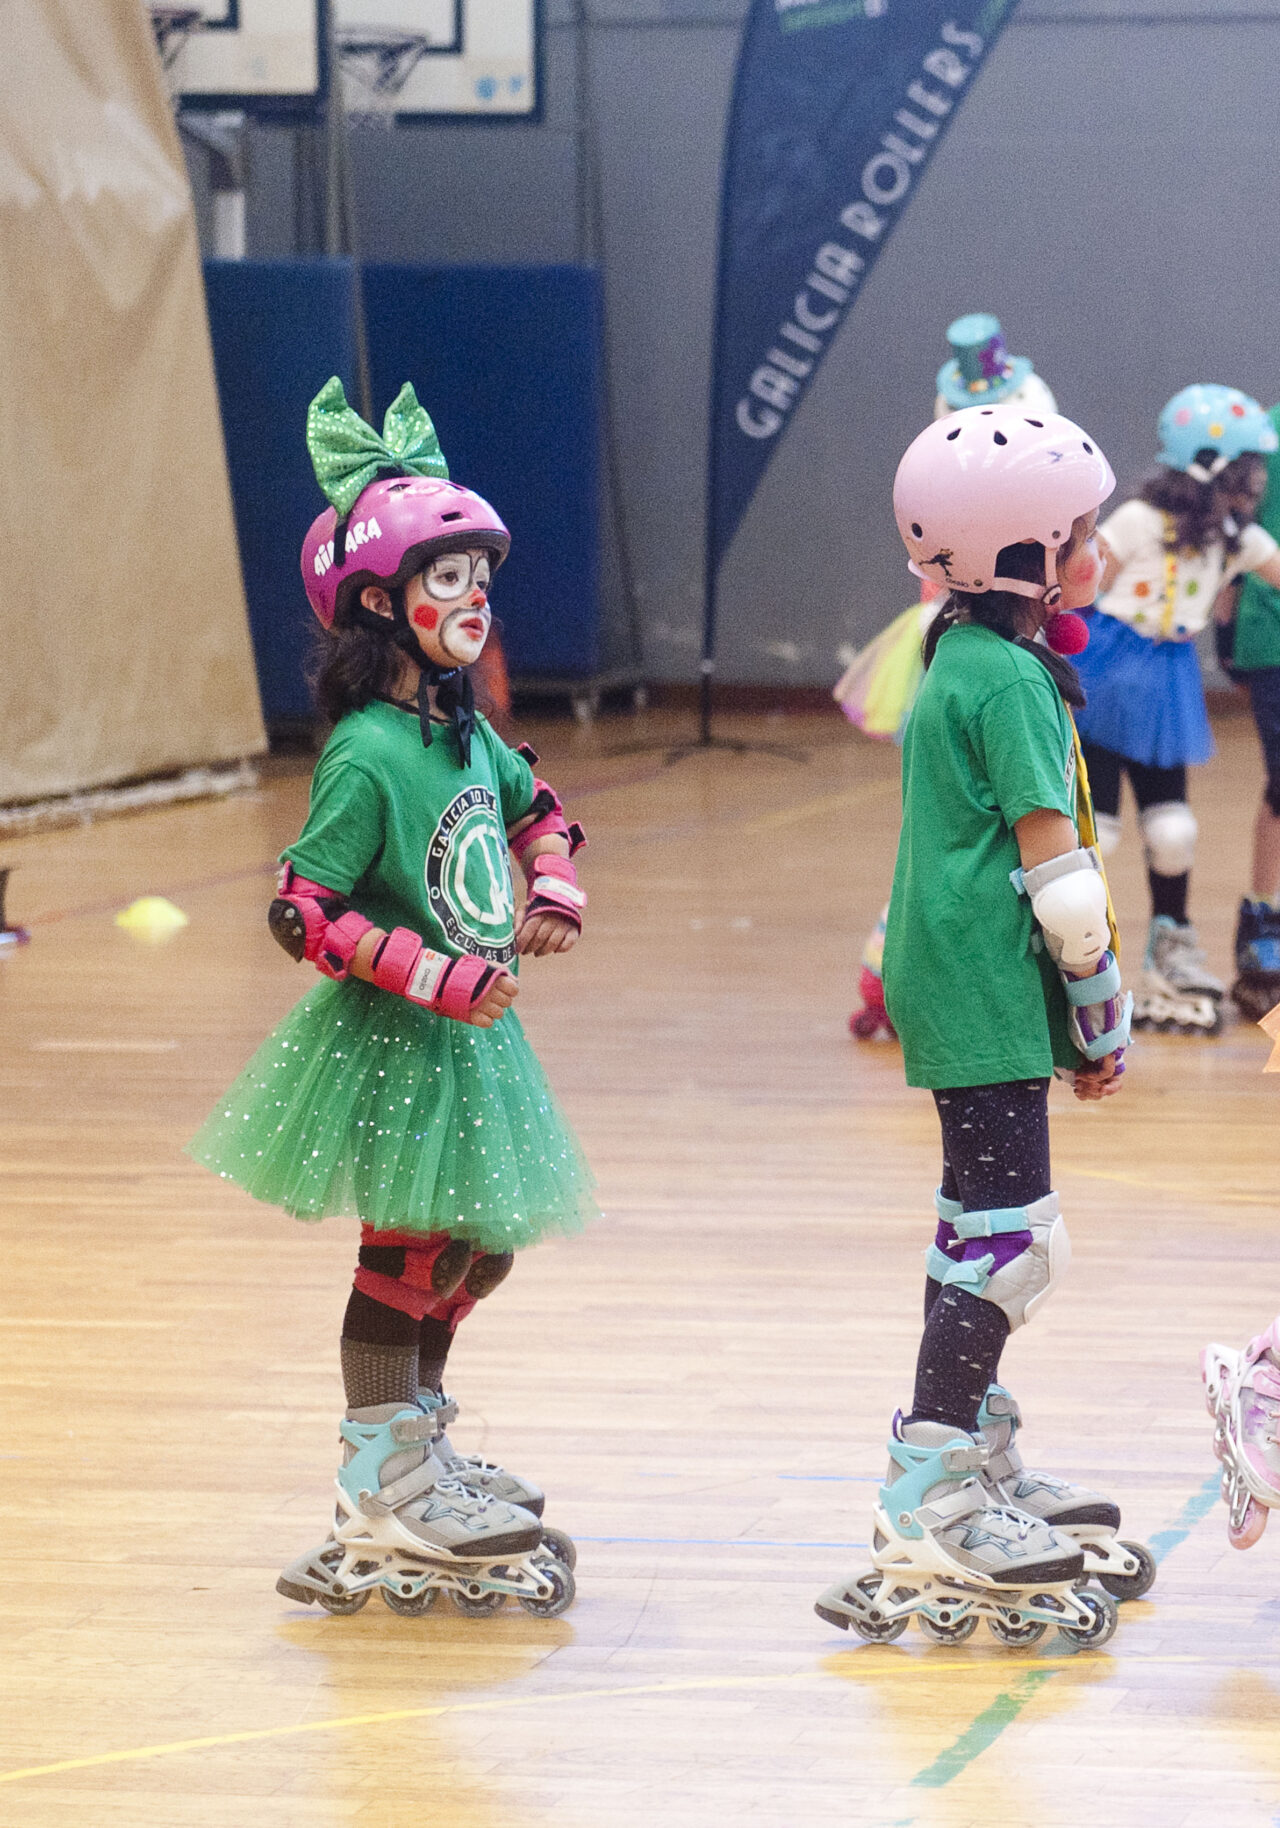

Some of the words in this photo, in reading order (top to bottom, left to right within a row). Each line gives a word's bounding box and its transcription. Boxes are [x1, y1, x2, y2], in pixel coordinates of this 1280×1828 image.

[735, 241, 866, 440] GALICIA
[840, 21, 986, 241] ROLLERS
[431, 796, 469, 858] GALICIA
[446, 916, 498, 961] ESCUELAS
[502, 946, 512, 962] DE
